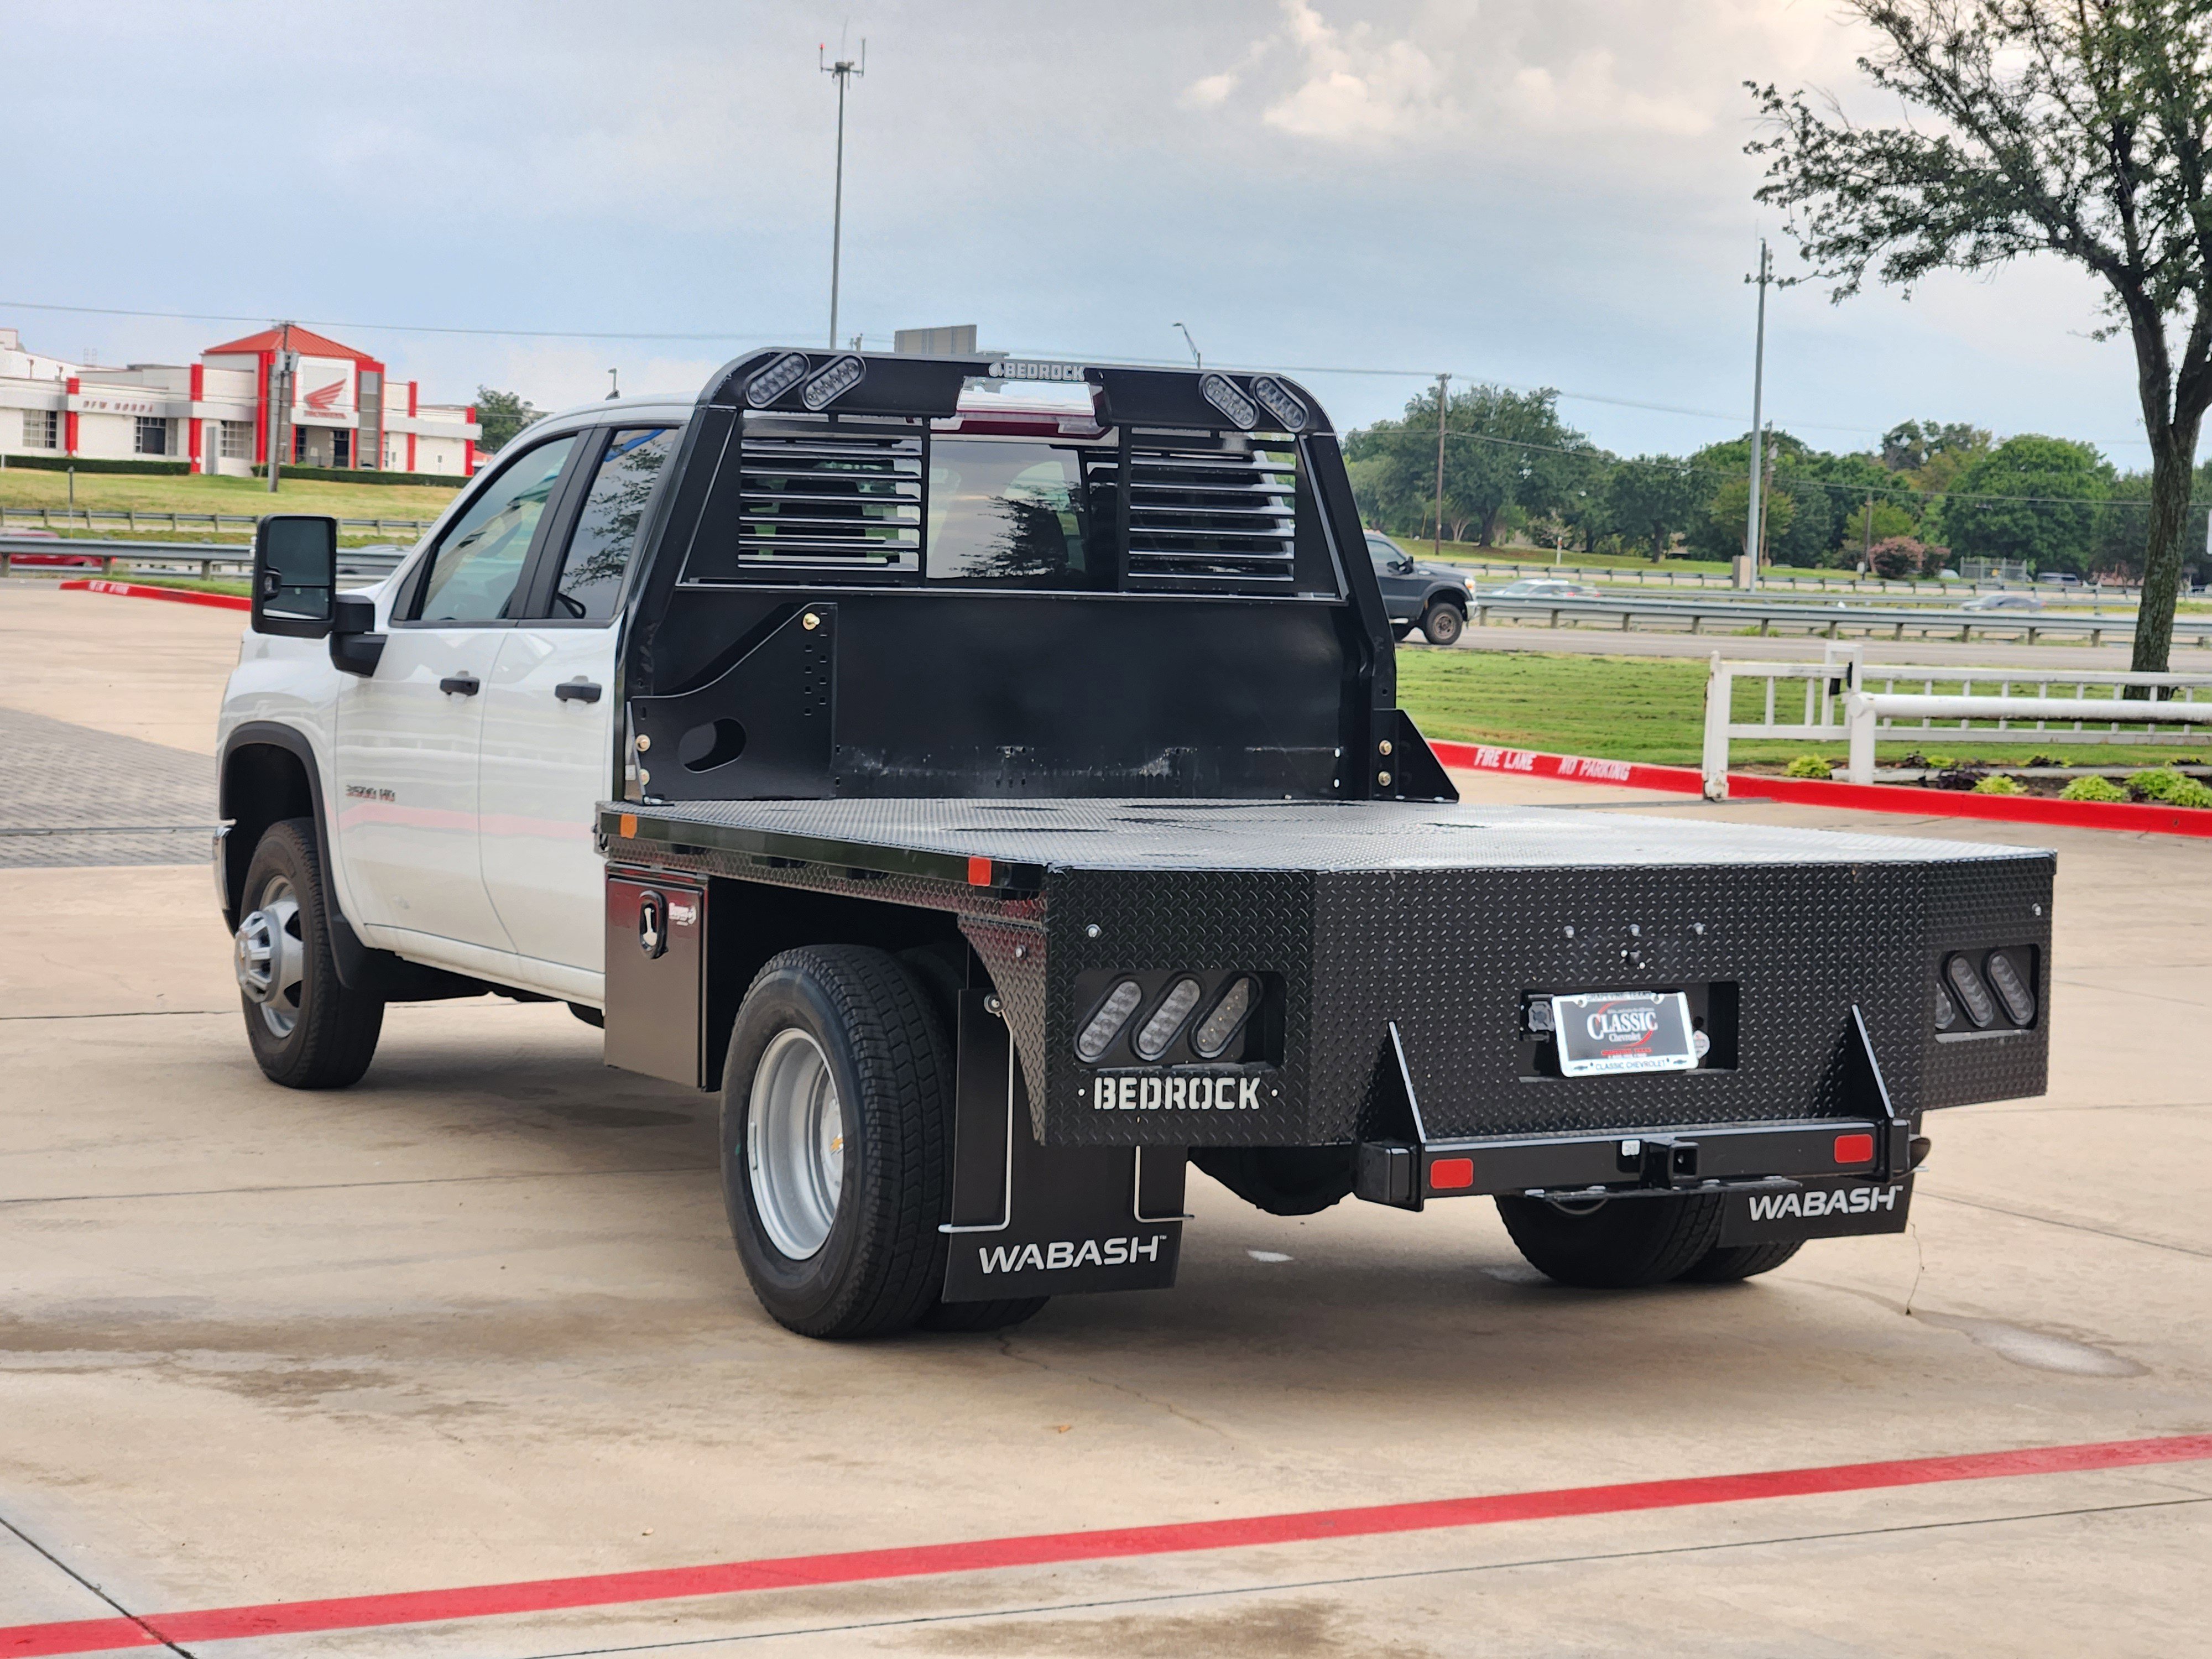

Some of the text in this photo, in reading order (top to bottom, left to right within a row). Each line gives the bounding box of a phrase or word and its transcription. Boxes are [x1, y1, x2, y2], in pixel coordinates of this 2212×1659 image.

[1004, 362, 1085, 382] BEDROCK
[303, 410, 347, 419] HONDA
[1474, 748, 1631, 781] FIRE LANE NO PARKING
[1587, 1011, 1658, 1040] CLASSIC
[1608, 1032, 1642, 1042] Chevrolet
[1595, 1060, 1666, 1071] CLASSIC CHEVROLET
[1094, 1077, 1261, 1110] BEDROCK
[1749, 1186, 1899, 1221] WABASH
[979, 1235, 1160, 1274] WABASH
